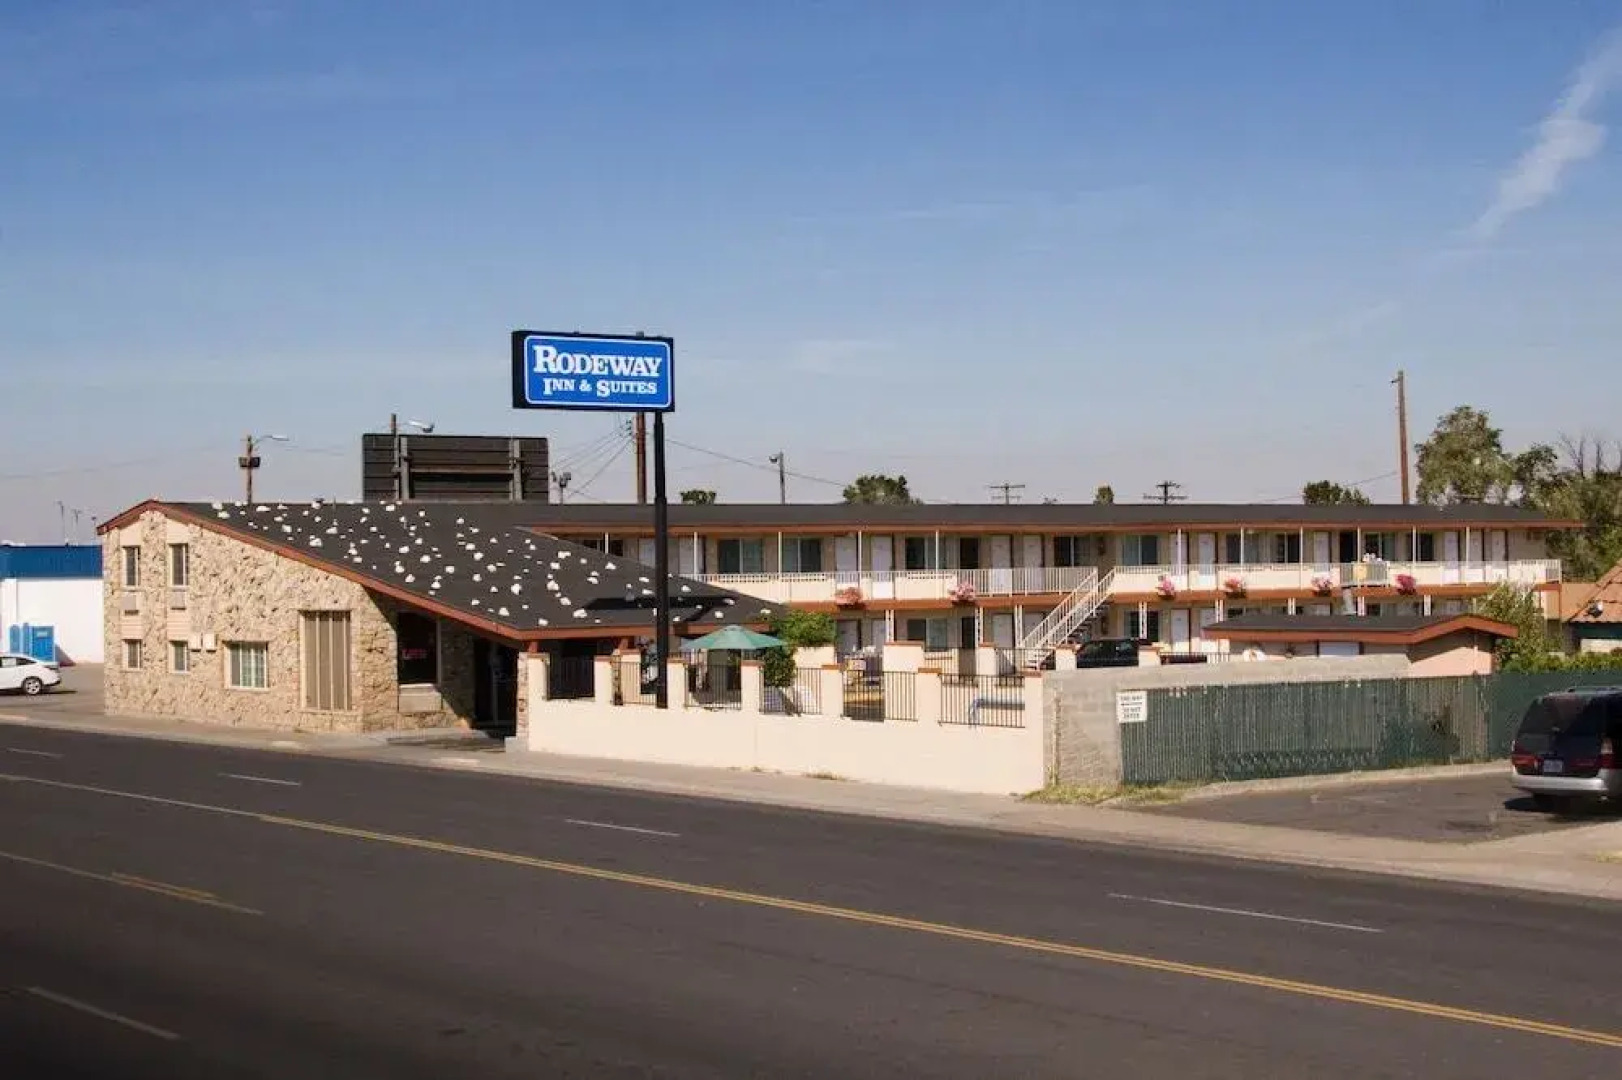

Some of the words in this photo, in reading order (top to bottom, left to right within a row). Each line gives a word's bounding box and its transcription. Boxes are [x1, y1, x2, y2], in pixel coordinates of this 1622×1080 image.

[533, 345, 662, 377] RODEWAY
[543, 378, 575, 395] INN
[579, 380, 592, 392] &
[596, 380, 658, 397] SUITES
